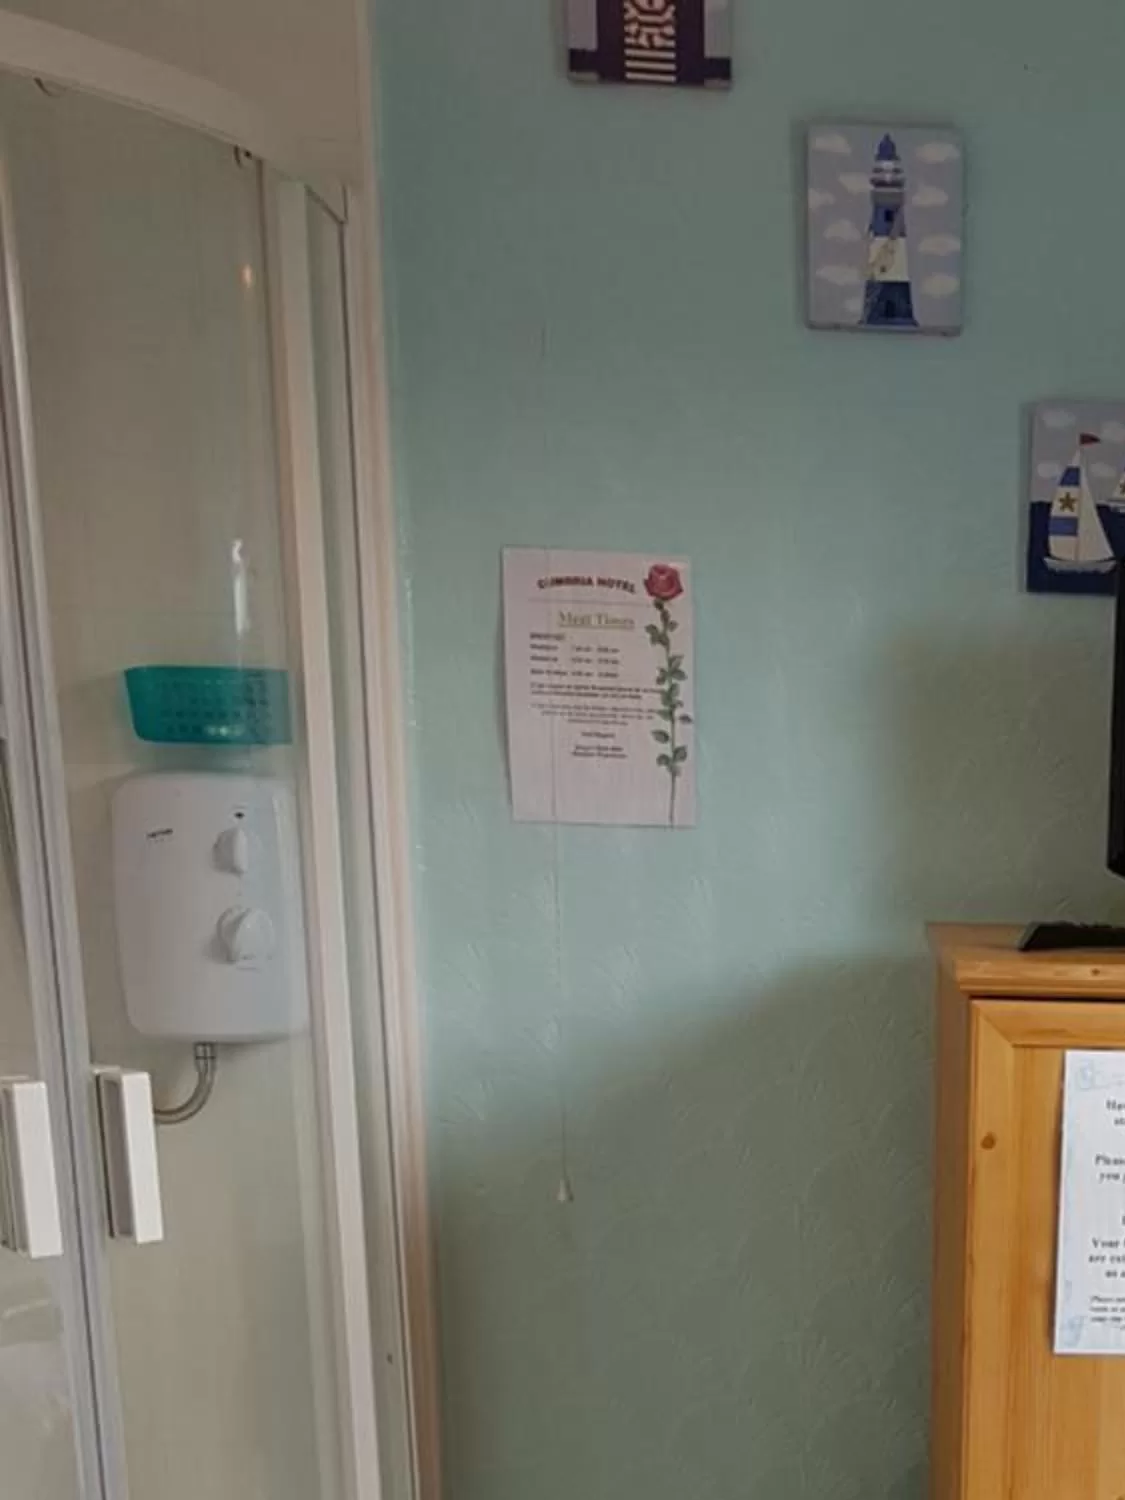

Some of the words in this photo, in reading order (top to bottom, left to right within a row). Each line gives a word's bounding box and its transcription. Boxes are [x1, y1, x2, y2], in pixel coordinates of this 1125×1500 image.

[537, 576, 593, 589] CUMBRIA
[597, 576, 636, 595] HOTEL
[1099, 1172, 1121, 1185] you
[1091, 1237, 1120, 1249] Your
[1088, 1255, 1106, 1263] are
